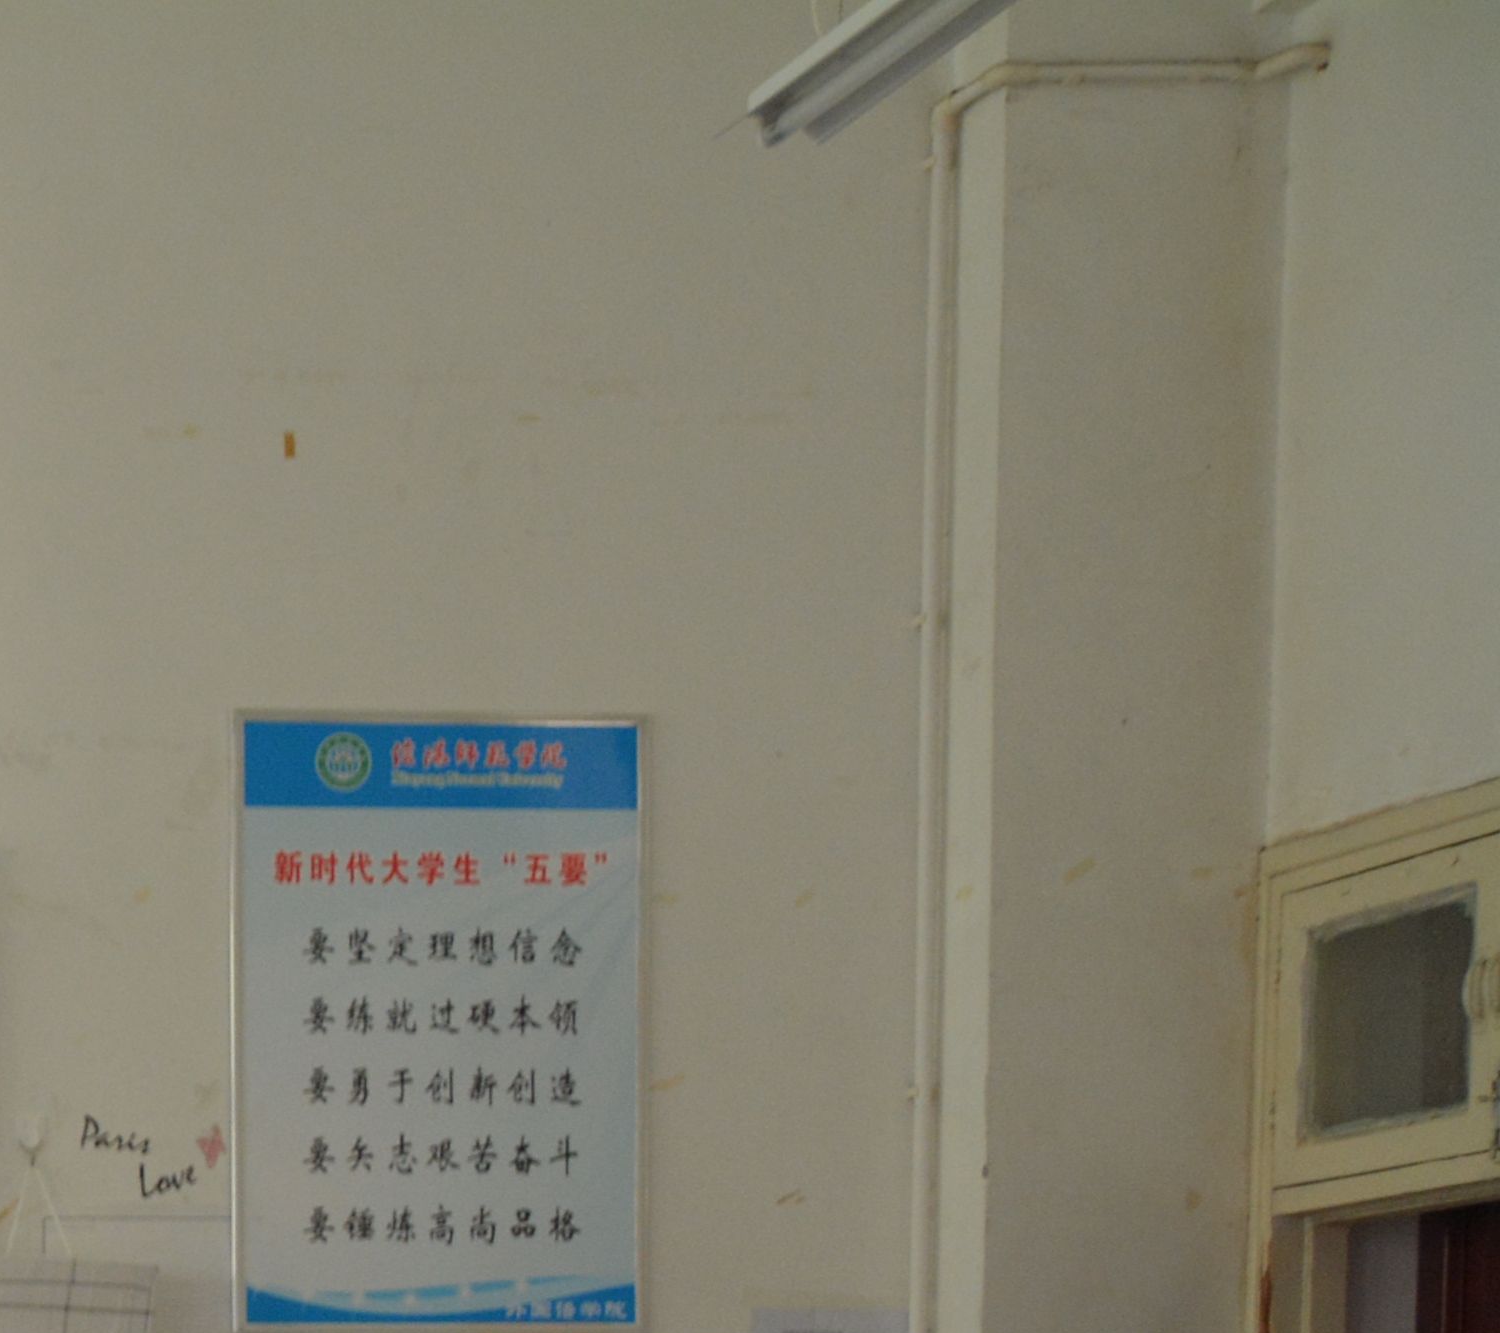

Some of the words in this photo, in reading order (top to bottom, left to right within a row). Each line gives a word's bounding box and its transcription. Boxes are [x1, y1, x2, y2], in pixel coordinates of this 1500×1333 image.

[302, 926, 583, 968] 要坚定理想信念
[302, 993, 580, 1036] 要练就过硬本领
[302, 1066, 582, 1108] 要勇于创新创造
[302, 1133, 580, 1178] 要矢志艰苦奋斗
[138, 1161, 197, 1199] Love
[302, 1204, 583, 1246] 要锤炼高尚品格
